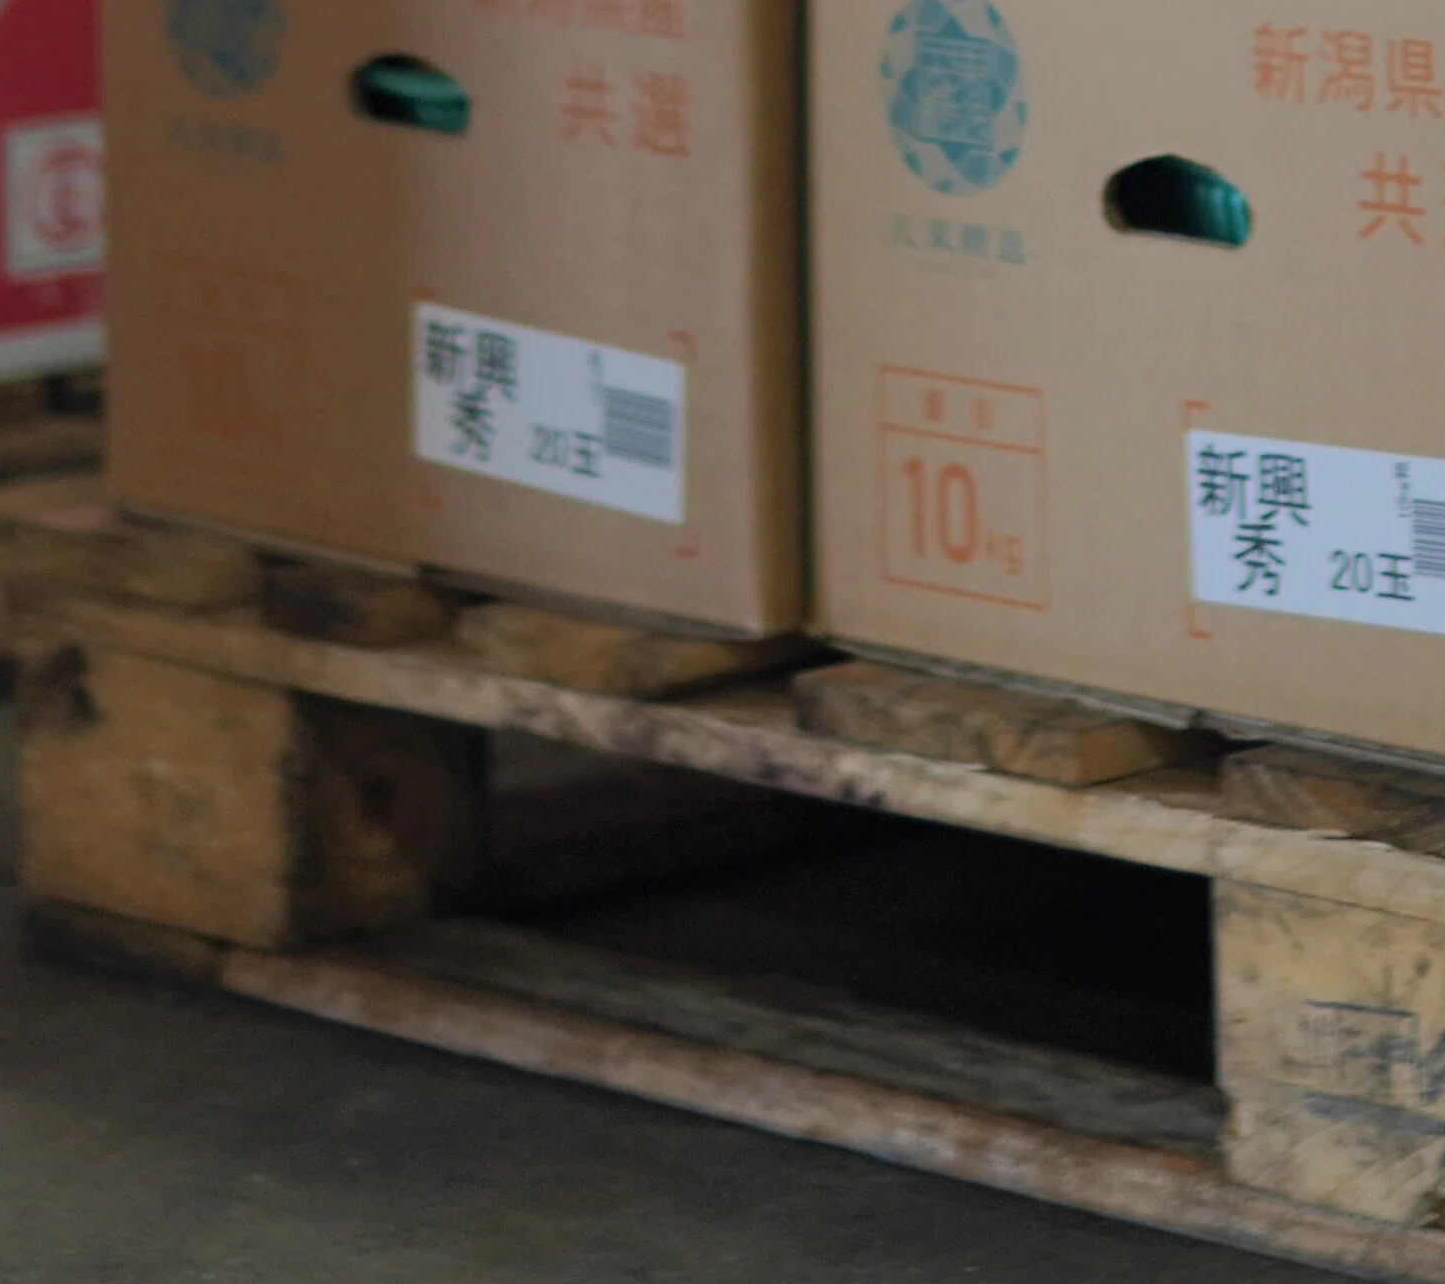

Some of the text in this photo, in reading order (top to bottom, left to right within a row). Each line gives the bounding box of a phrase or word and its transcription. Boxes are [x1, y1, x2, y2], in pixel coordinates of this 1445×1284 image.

[1196, 446, 1312, 527] 新興
[1233, 523, 1415, 602] 秀 20玉
